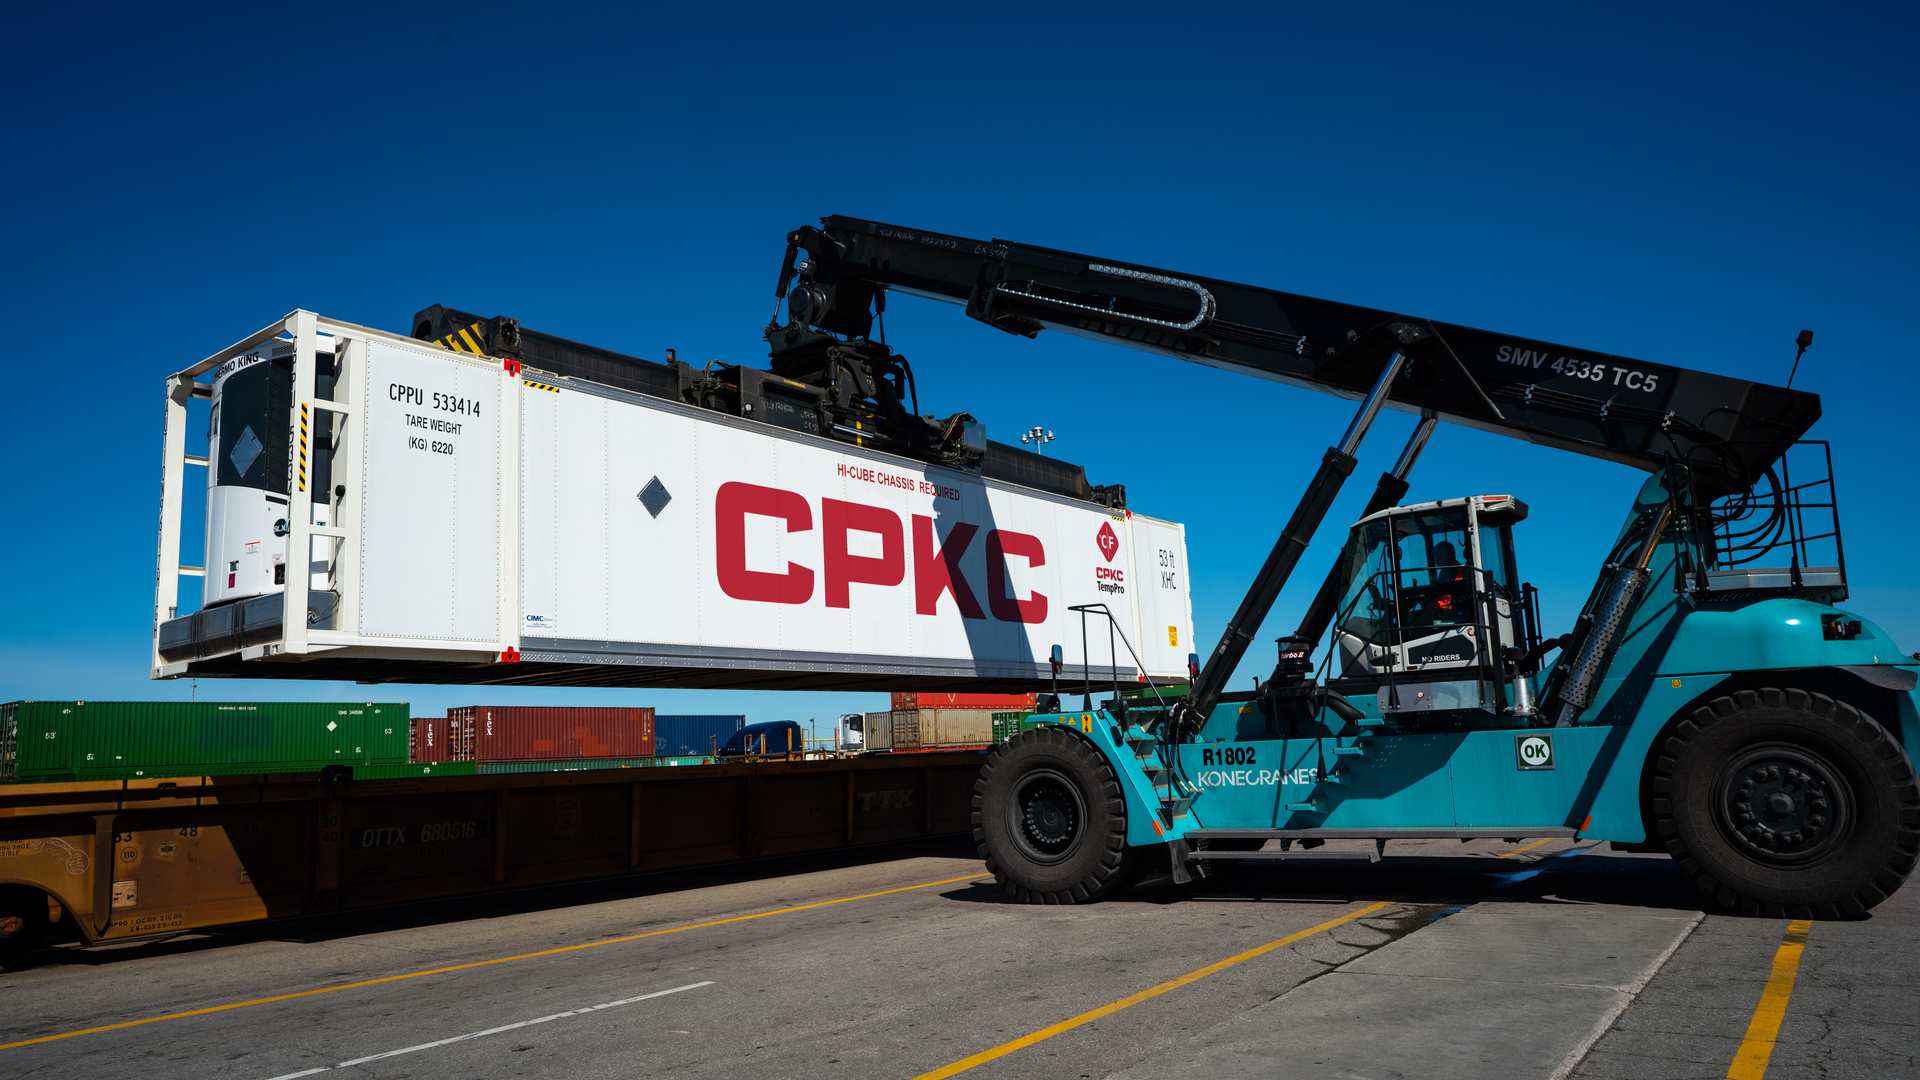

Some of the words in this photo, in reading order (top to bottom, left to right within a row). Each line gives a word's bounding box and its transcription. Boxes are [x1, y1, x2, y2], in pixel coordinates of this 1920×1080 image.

[237, 351, 259, 369] KING
[1496, 344, 1548, 369] SMV
[1550, 356, 1606, 382] 4535
[1611, 366, 1659, 393] TC5
[389, 383, 423, 406] CPPU
[433, 392, 480, 418] 533414
[406, 413, 428, 429] TARE
[430, 418, 462, 435] WEIGHT
[408, 436, 428, 451] (KG)
[432, 441, 454, 456] 6220
[837, 463, 875, 484] HI-CUBE
[877, 472, 915, 492] CHASSIS
[919, 481, 960, 501] REQUIRED
[715, 480, 1048, 625] CPKC
[1158, 549, 1169, 568] 53
[1169, 550, 1176, 569] ft
[1096, 566, 1124, 582] CPKC
[1160, 570, 1177, 590] XHC
[1097, 581, 1125, 596] TempPro
[1433, 654, 1461, 662] RIDERS
[1202, 746, 1257, 766] R1802
[1525, 744, 1547, 759] OK
[1197, 768, 1318, 787] KONECRANES
[857, 788, 915, 812] TTX
[179, 825, 198, 838] 48
[241, 821, 260, 833] 45
[322, 816, 338, 828] 20
[321, 831, 338, 843] 40
[361, 826, 406, 849] DTTX
[421, 820, 477, 843] 680516
[123, 851, 135, 859] 110
[415, 848, 426, 857] LD
[428, 847, 445, 856] LMT
[446, 845, 477, 854] 169200
